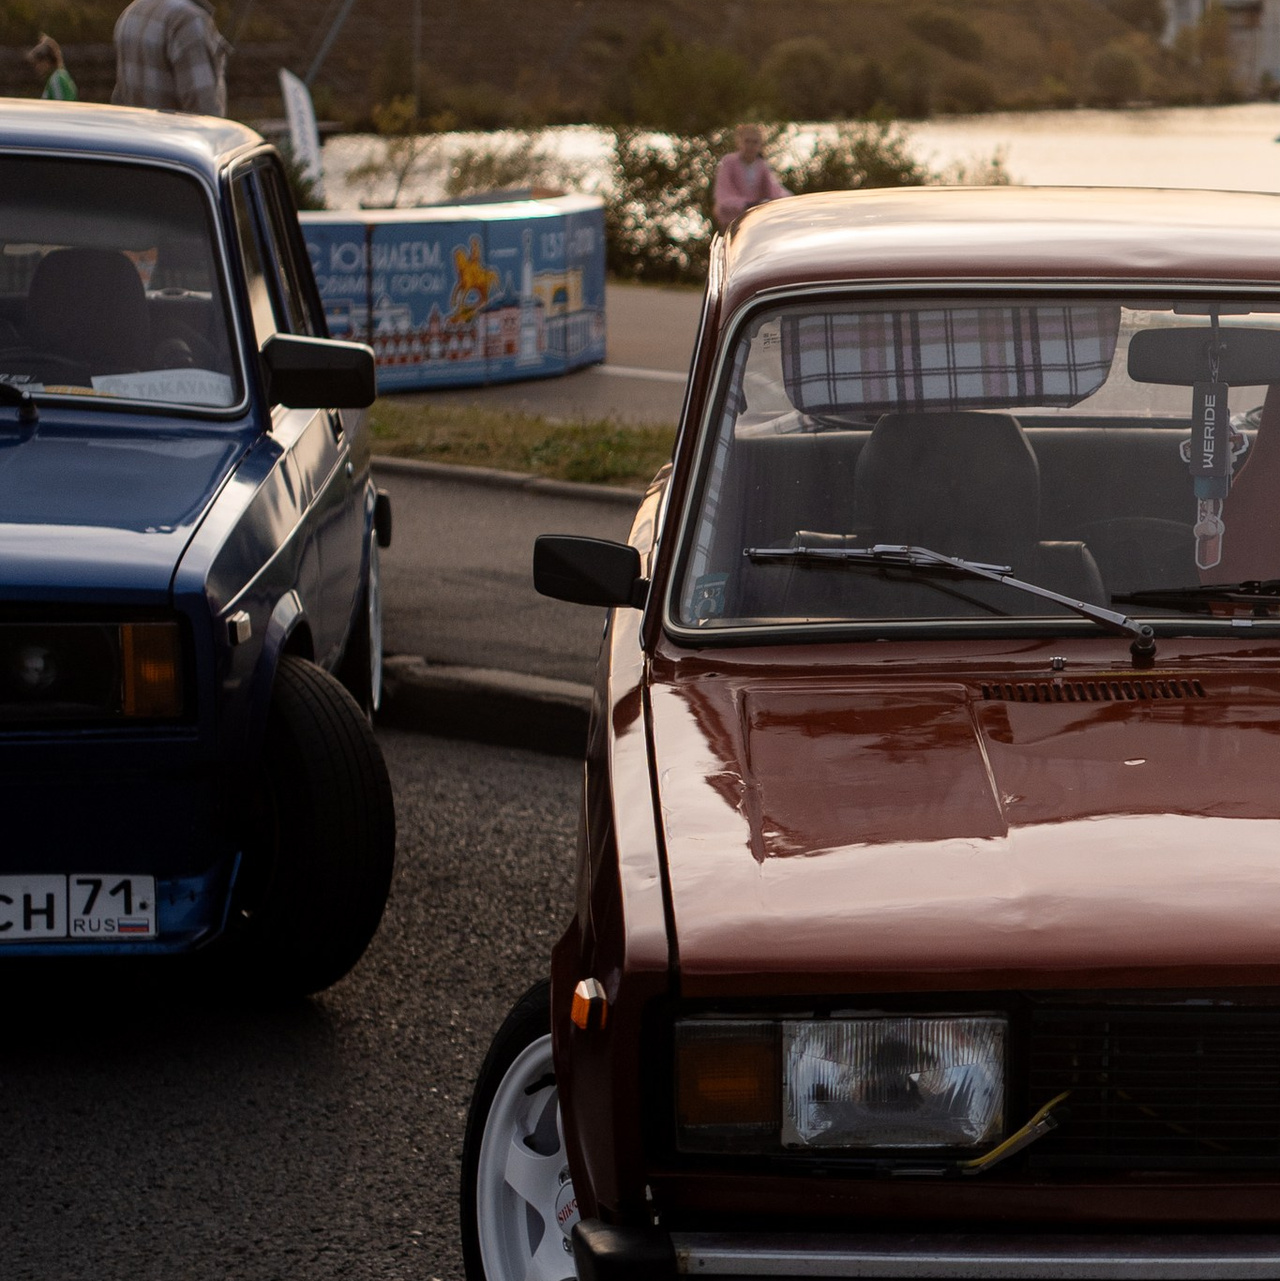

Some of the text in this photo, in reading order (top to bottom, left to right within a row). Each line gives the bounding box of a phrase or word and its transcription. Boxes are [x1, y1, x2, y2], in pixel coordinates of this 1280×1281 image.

[1202, 393, 1216, 469] WERIDE
[76, 879, 132, 915] 71
[74, 919, 115, 932] RUS
